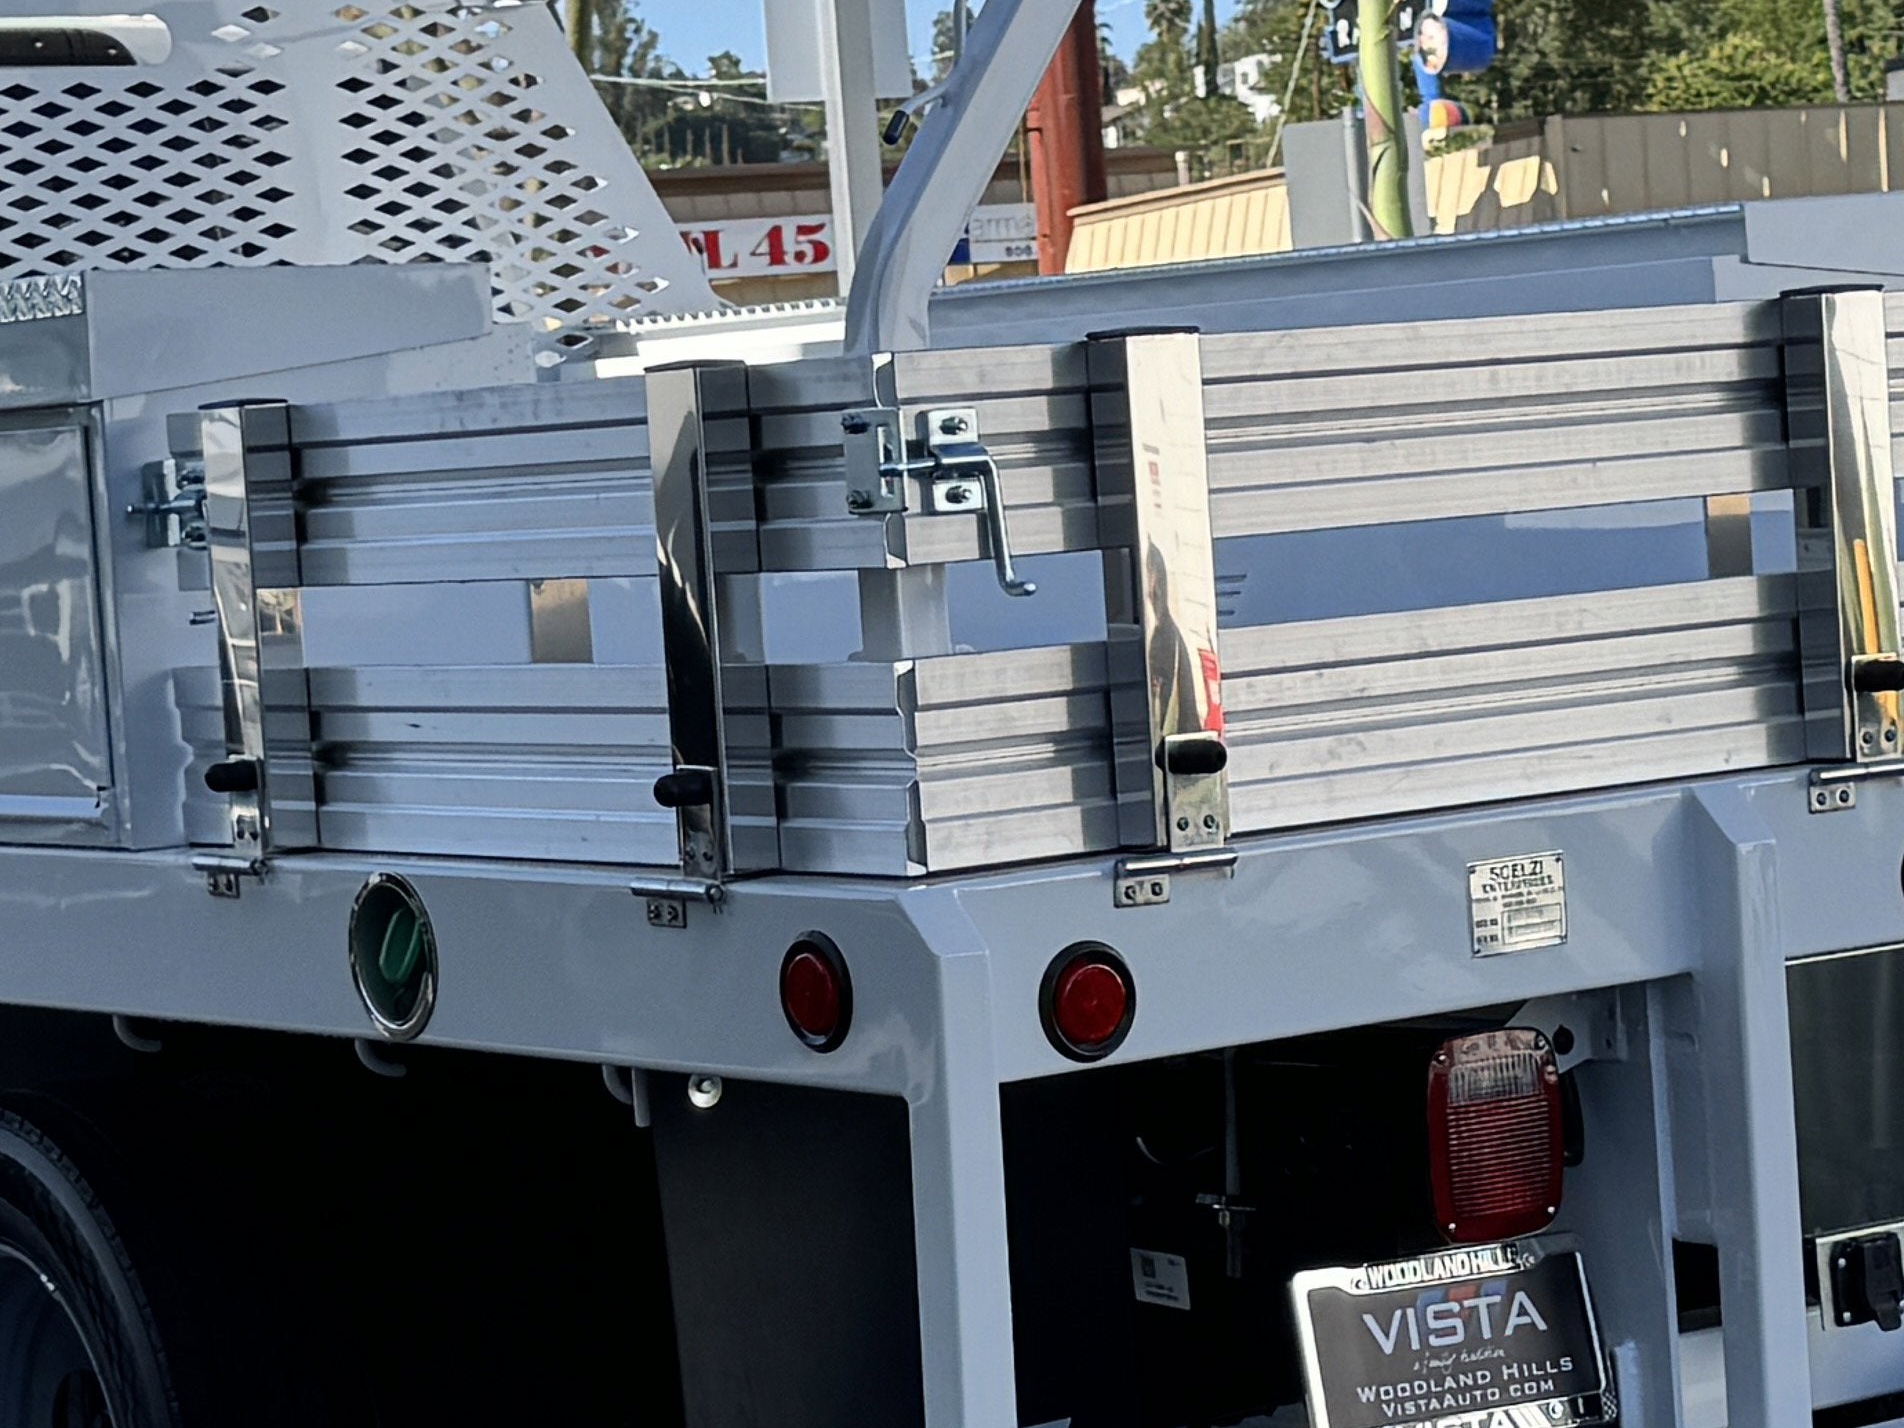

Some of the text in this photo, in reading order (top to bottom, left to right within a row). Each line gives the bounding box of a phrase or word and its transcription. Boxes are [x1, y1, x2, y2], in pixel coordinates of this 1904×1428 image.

[750, 222, 831, 267] 45
[1489, 860, 1544, 881] SCELZI
[1367, 1252, 1470, 1290] WOODLAND
[1362, 1290, 1548, 1356] VISTA
[1356, 1370, 1491, 1405] WOODLAND
[1501, 1356, 1574, 1381] HILLS
